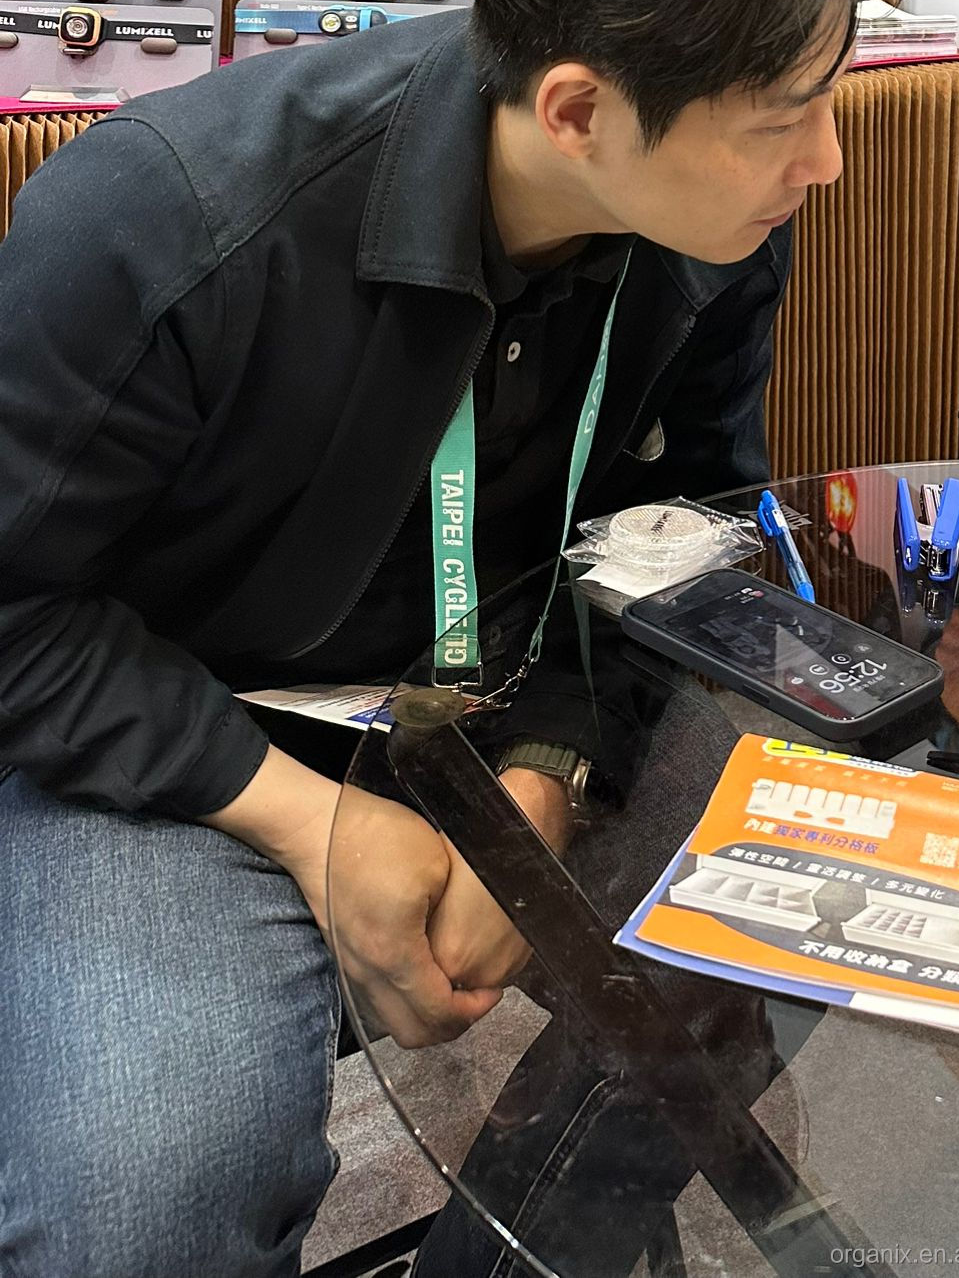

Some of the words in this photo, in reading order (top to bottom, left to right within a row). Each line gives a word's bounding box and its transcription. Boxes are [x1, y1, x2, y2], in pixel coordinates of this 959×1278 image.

[115, 26, 174, 36] LUMIXELL
[440, 469, 465, 547] TAIPEI
[444, 558, 468, 632] CYCLE
[818, 658, 888, 694] 12:56
[798, 940, 913, 973] 不用收納盒
